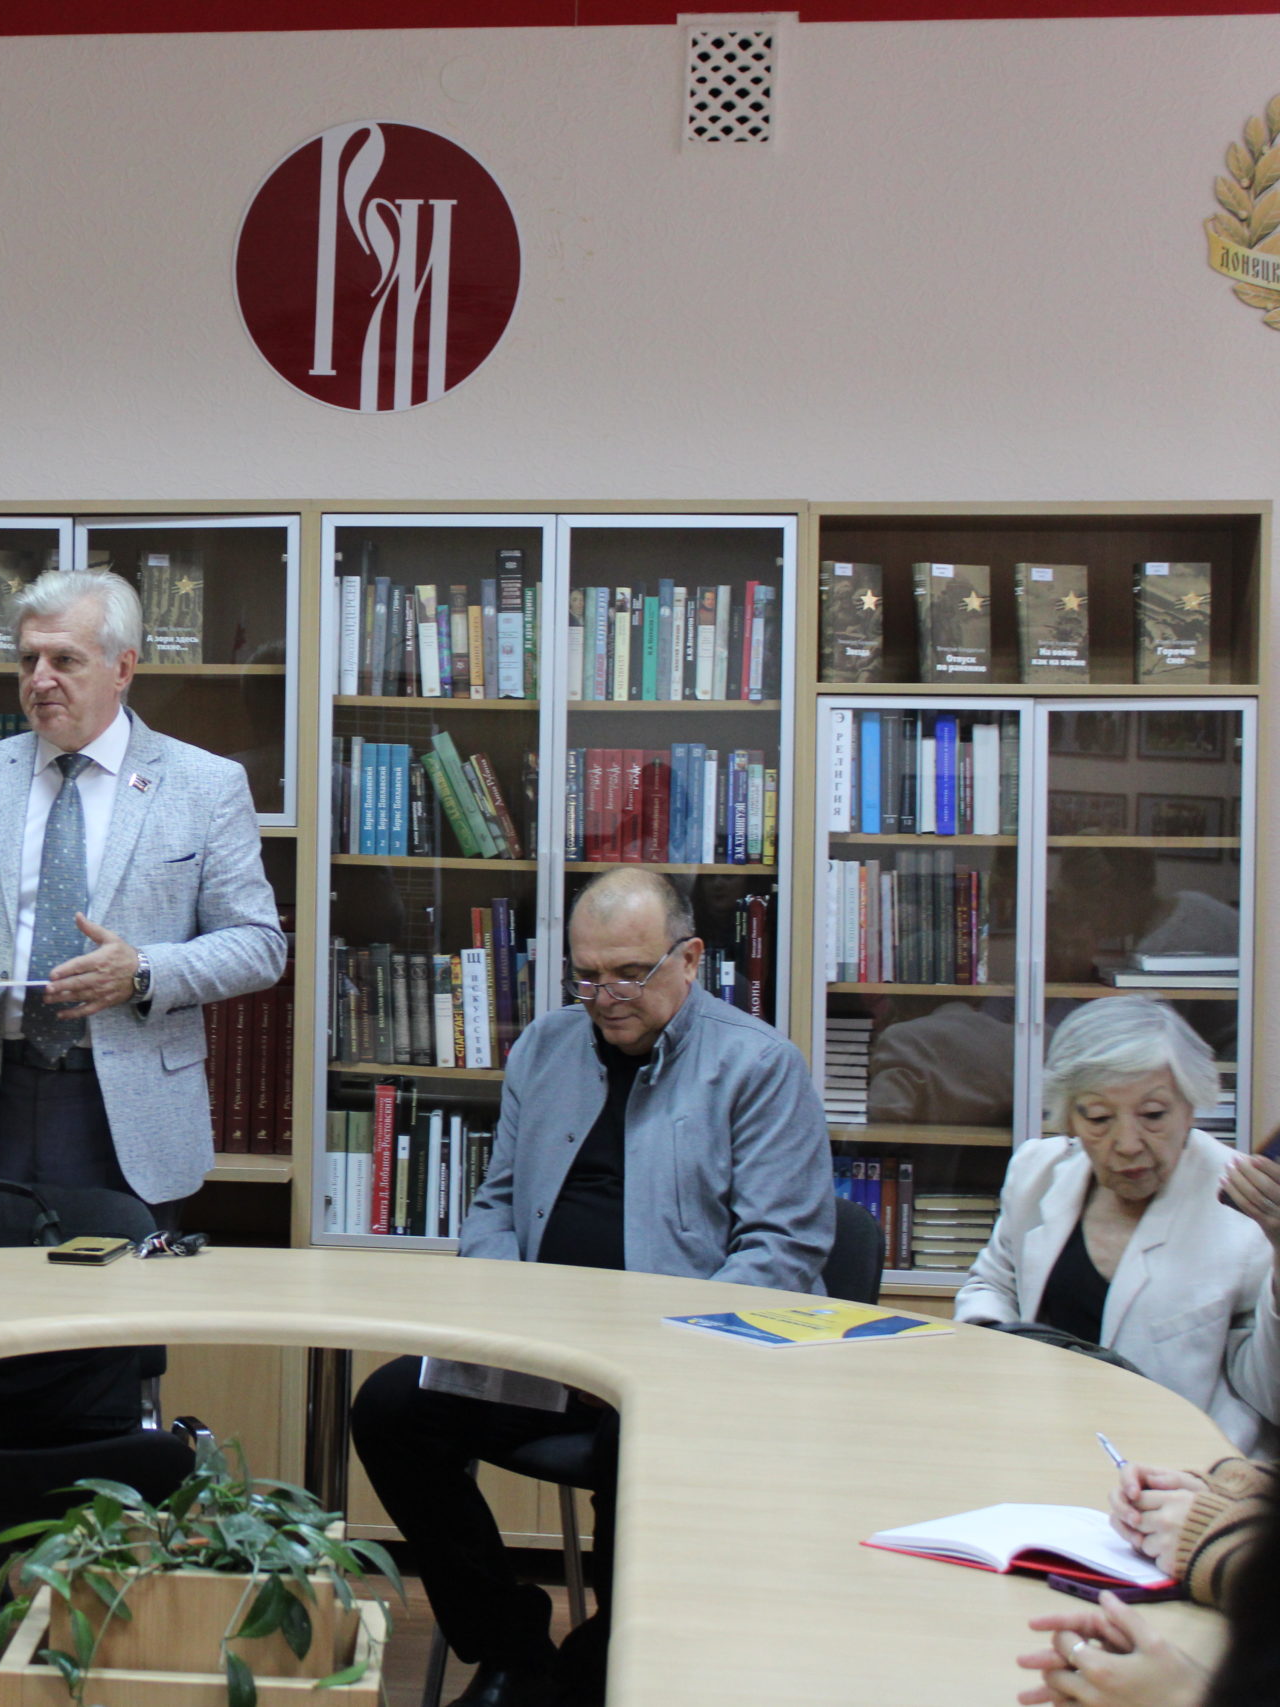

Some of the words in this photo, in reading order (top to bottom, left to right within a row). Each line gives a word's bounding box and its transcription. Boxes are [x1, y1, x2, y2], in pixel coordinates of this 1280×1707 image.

[363, 809, 375, 831] Борис
[377, 809, 388, 831] Борис
[392, 810, 402, 832] Борис
[471, 974, 484, 1065] ИСКУССТВО
[379, 1097, 393, 1189] Лобанов-Ростовский
[377, 1200, 388, 1232] Никита
